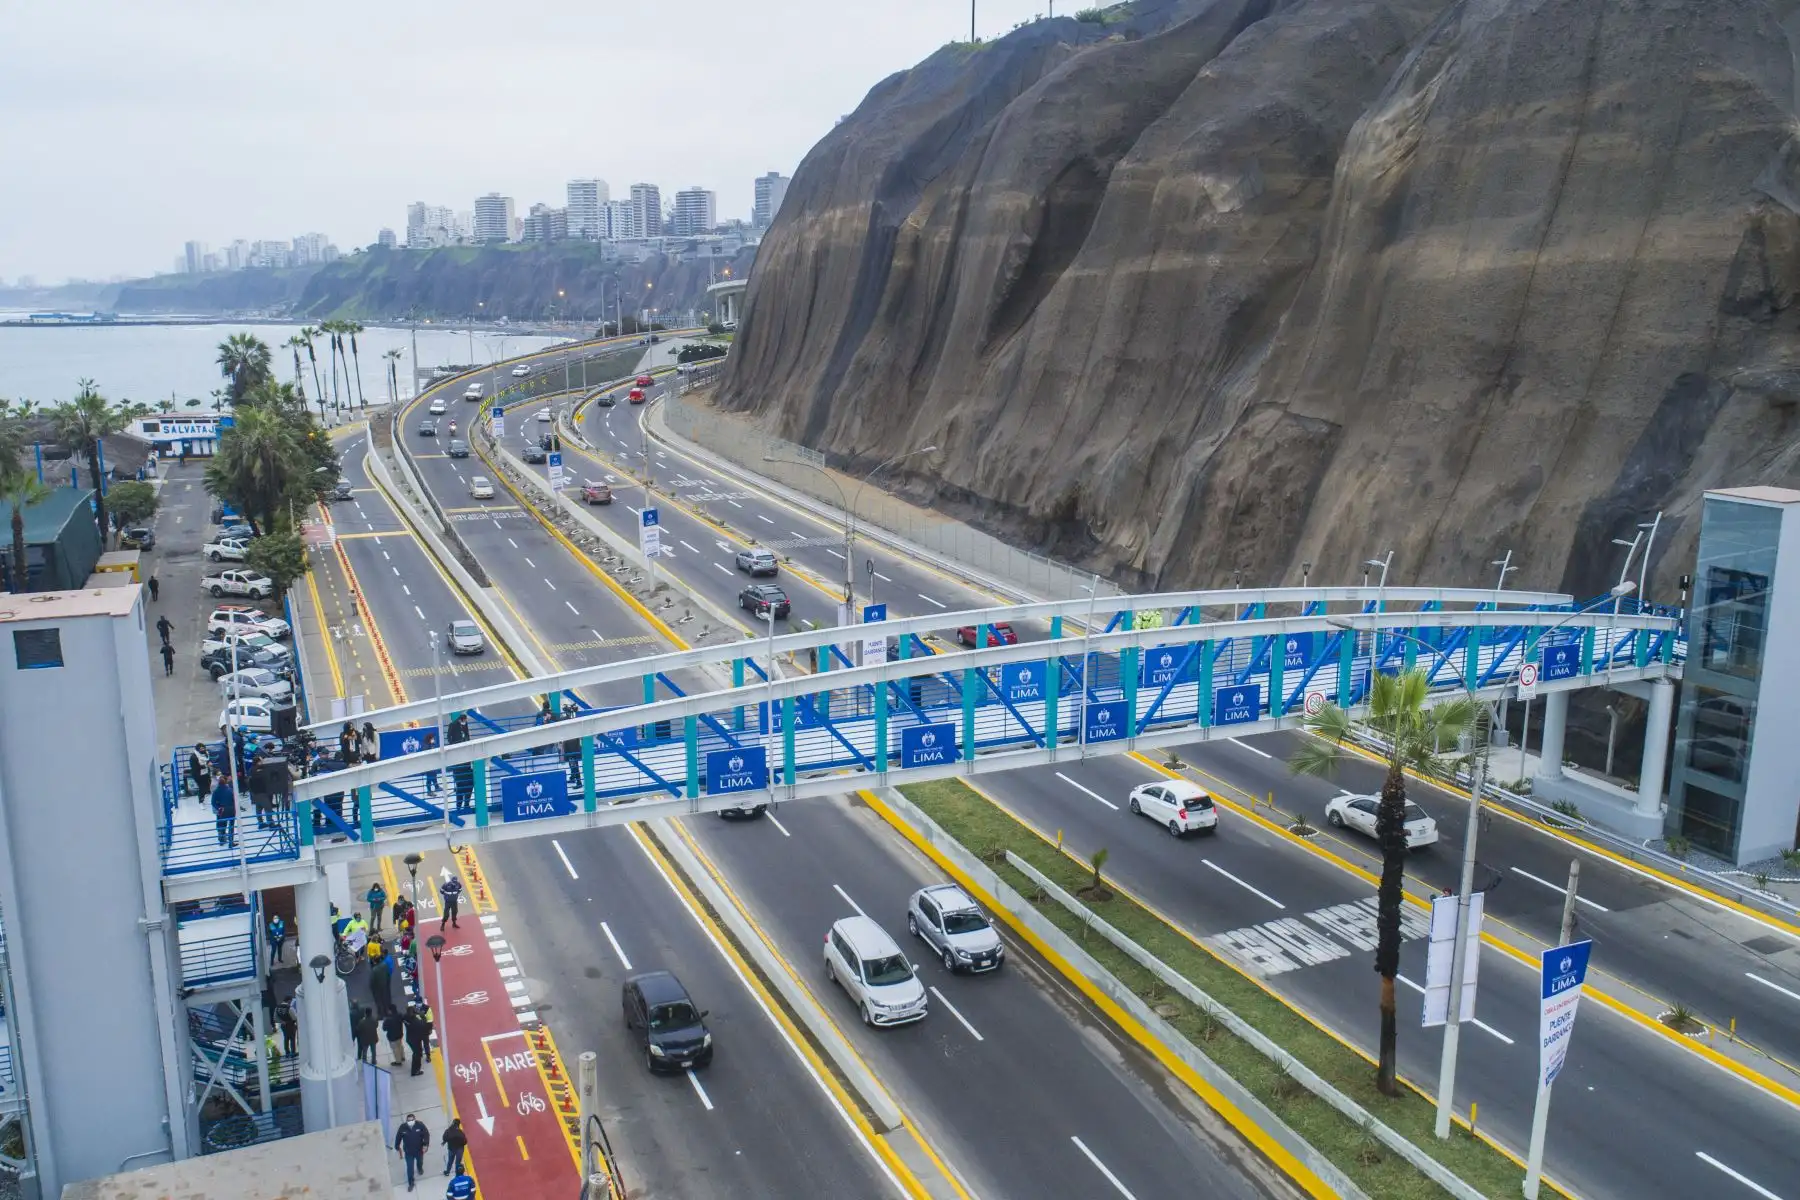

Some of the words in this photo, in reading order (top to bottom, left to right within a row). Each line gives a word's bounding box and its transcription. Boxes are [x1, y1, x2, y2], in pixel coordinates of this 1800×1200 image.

[164, 425, 217, 434] SALVATAJ
[1284, 657, 1303, 667] IMA
[1153, 672, 1172, 683] LIM
[1551, 668, 1575, 677] LIMA
[1010, 688, 1039, 699] LIMA
[1225, 710, 1250, 721] LIMA
[772, 716, 803, 728] LIA
[1090, 728, 1117, 739] LIMA
[914, 751, 945, 763] LIMA
[720, 777, 753, 789] LIMA
[517, 803, 554, 816] LIMA
[1552, 976, 1576, 993] LIMA
[493, 1050, 536, 1074] PARE
